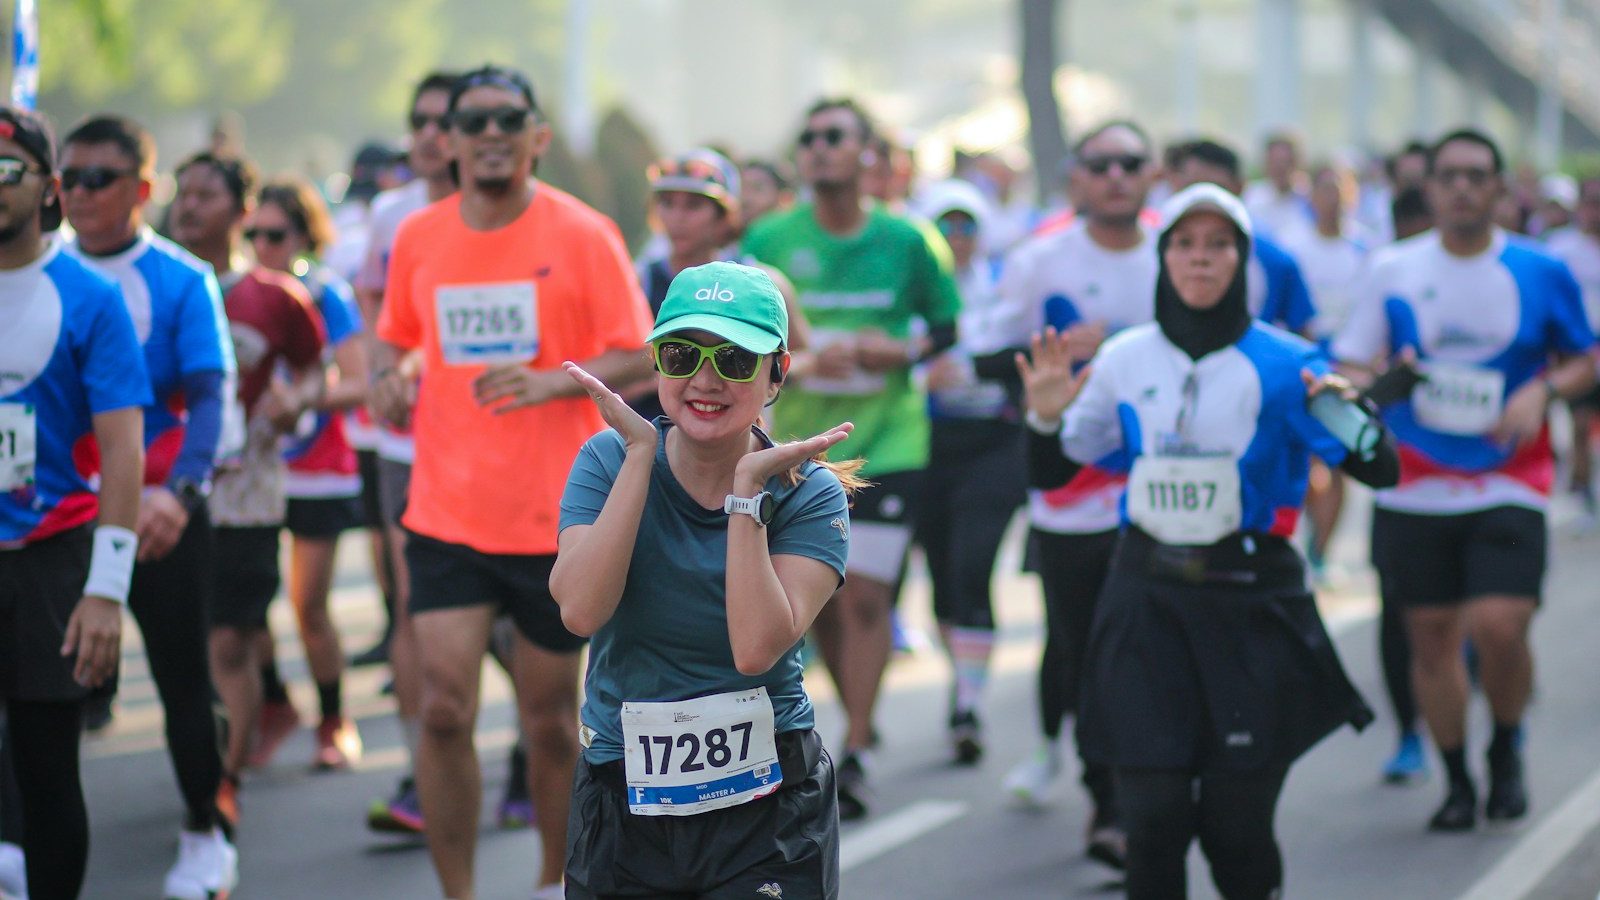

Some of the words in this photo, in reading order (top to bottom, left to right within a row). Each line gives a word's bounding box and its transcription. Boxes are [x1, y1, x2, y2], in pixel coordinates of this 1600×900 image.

[695, 281, 734, 302] alo
[446, 305, 525, 336] 17265
[1147, 480, 1217, 512] 11187
[638, 721, 753, 775] 17287
[635, 787, 645, 804] F
[698, 789, 729, 801] MASTER
